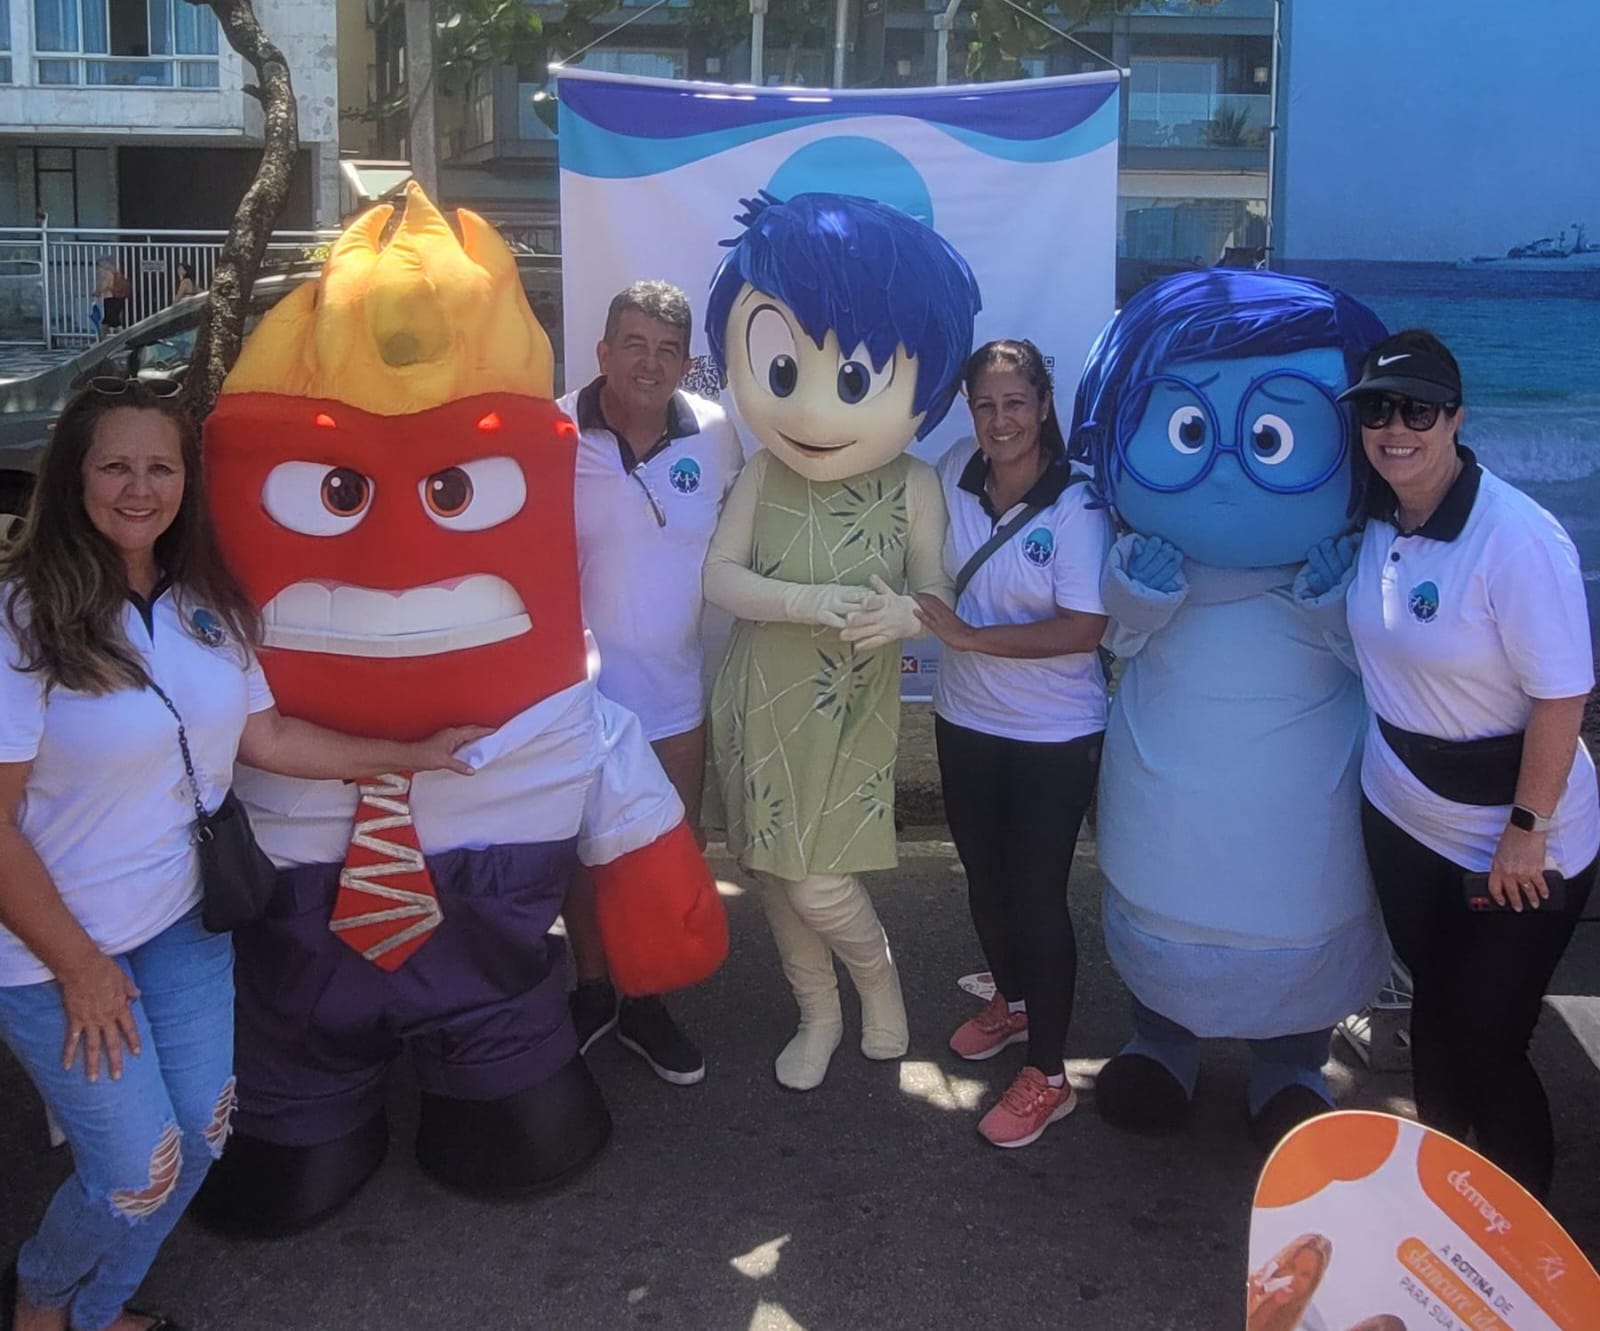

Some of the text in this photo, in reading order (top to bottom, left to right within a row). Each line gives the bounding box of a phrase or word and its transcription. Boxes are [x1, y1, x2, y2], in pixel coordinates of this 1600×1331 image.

[1447, 1170, 1512, 1234] dermage
[1400, 1275, 1454, 1329] PARA SUA
[1407, 1248, 1474, 1313] skincare
[1439, 1244, 1515, 1316] A ROTINA DE
